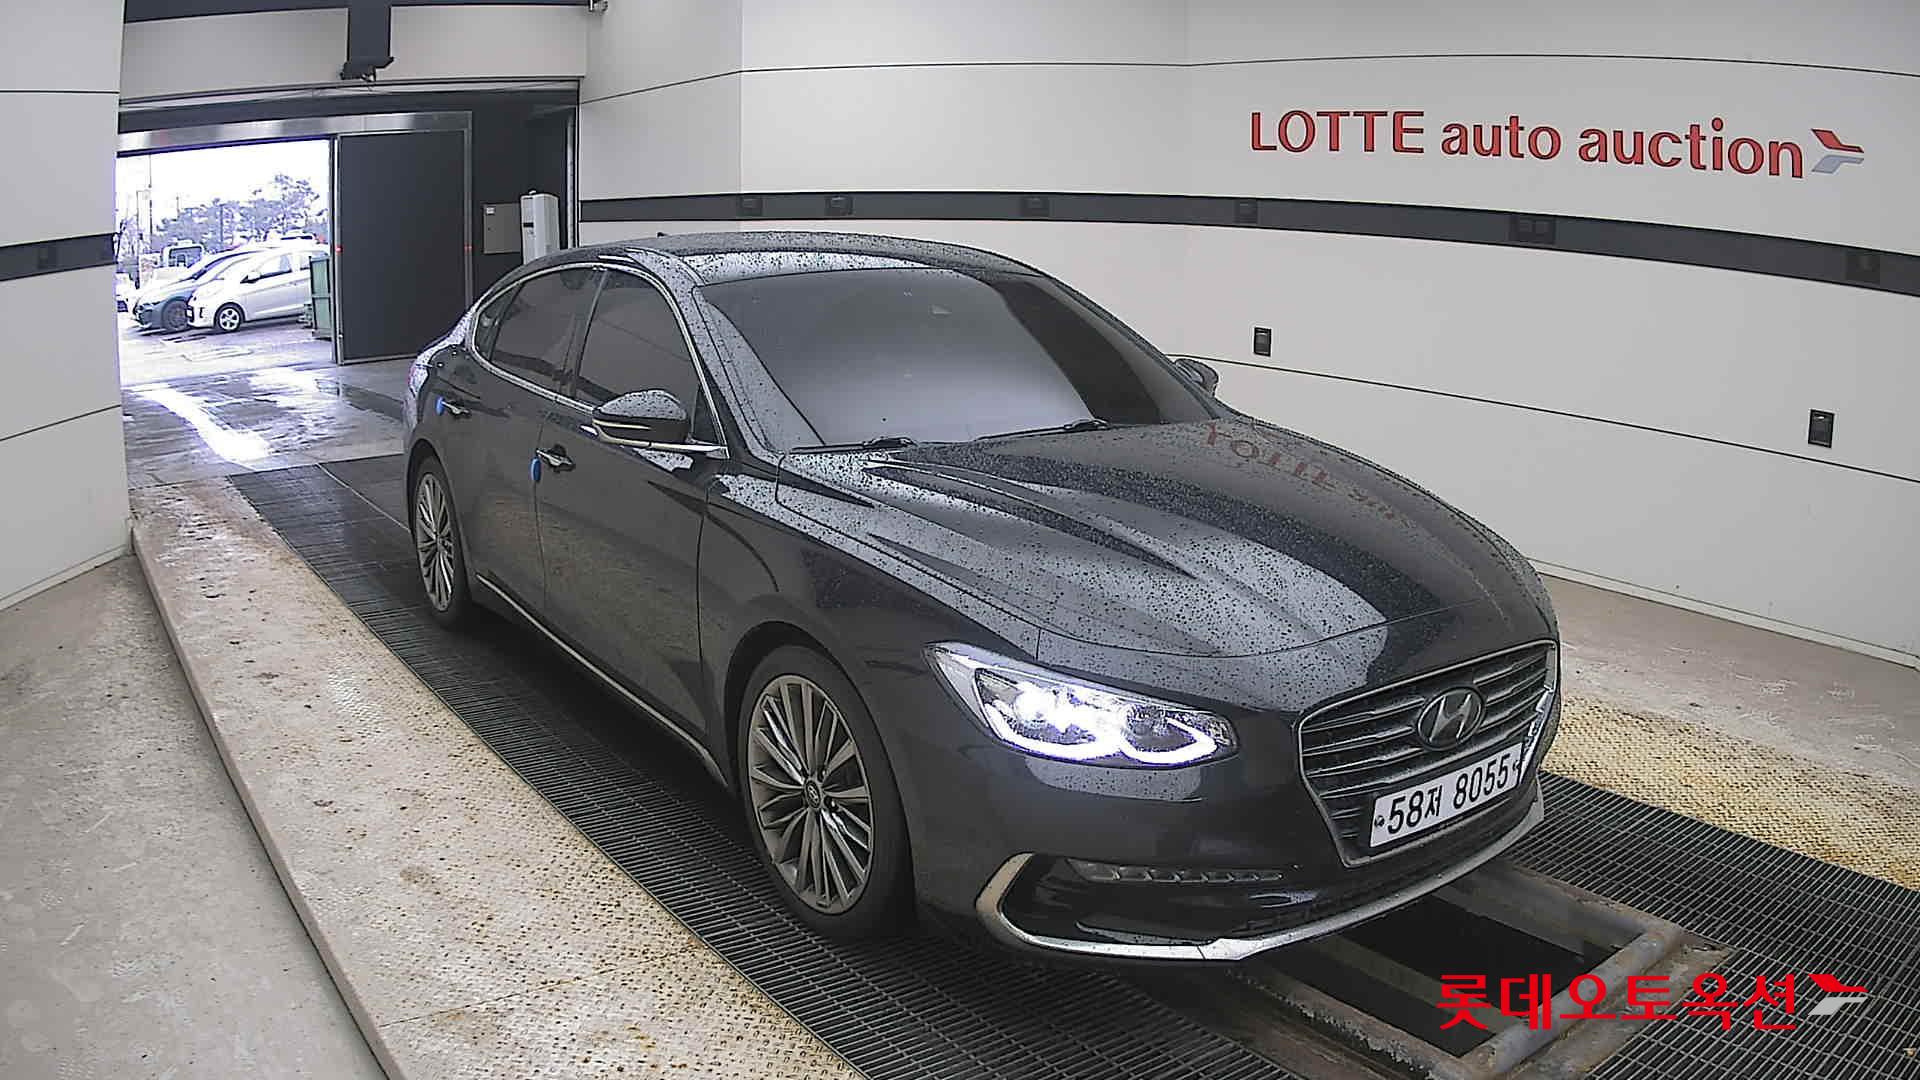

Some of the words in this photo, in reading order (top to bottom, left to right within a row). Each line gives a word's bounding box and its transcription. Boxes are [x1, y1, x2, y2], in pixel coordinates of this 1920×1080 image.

[1251, 110, 1425, 154] LOTTE
[1441, 116, 1562, 160] auto
[1578, 117, 1804, 178] auction
[1387, 784, 1443, 834] 58저
[1453, 753, 1511, 809] 8055
